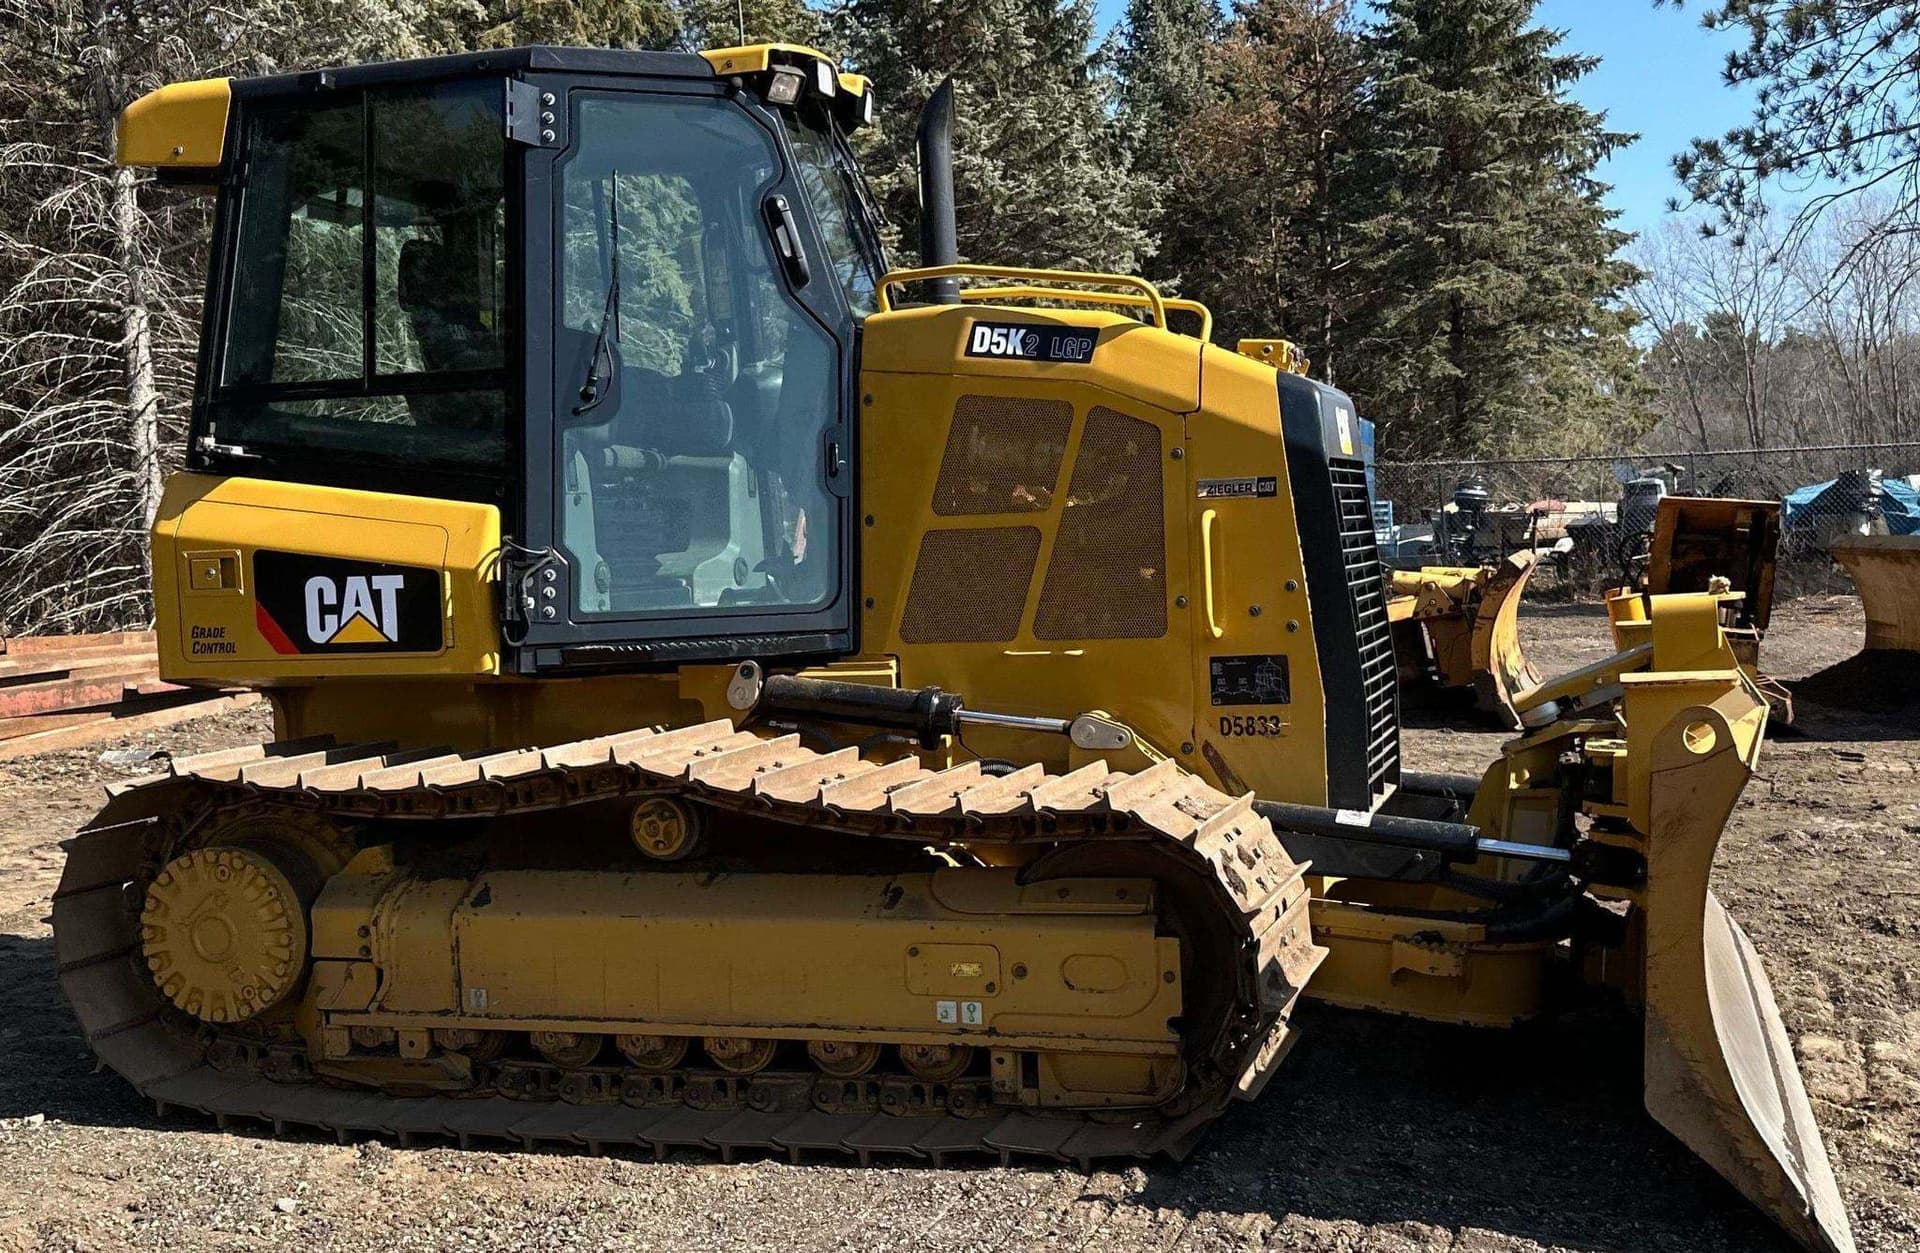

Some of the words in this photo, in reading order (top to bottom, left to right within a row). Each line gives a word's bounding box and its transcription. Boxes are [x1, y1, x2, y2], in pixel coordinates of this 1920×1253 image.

[1050, 336, 1092, 359] LGP
[1207, 483, 1252, 495] ZIEGLER
[1258, 481, 1275, 493] CAT
[305, 575, 404, 644] CAT
[191, 625, 226, 639] GRADE
[192, 641, 237, 654] CONTROL
[1220, 715, 1281, 736] D5833
